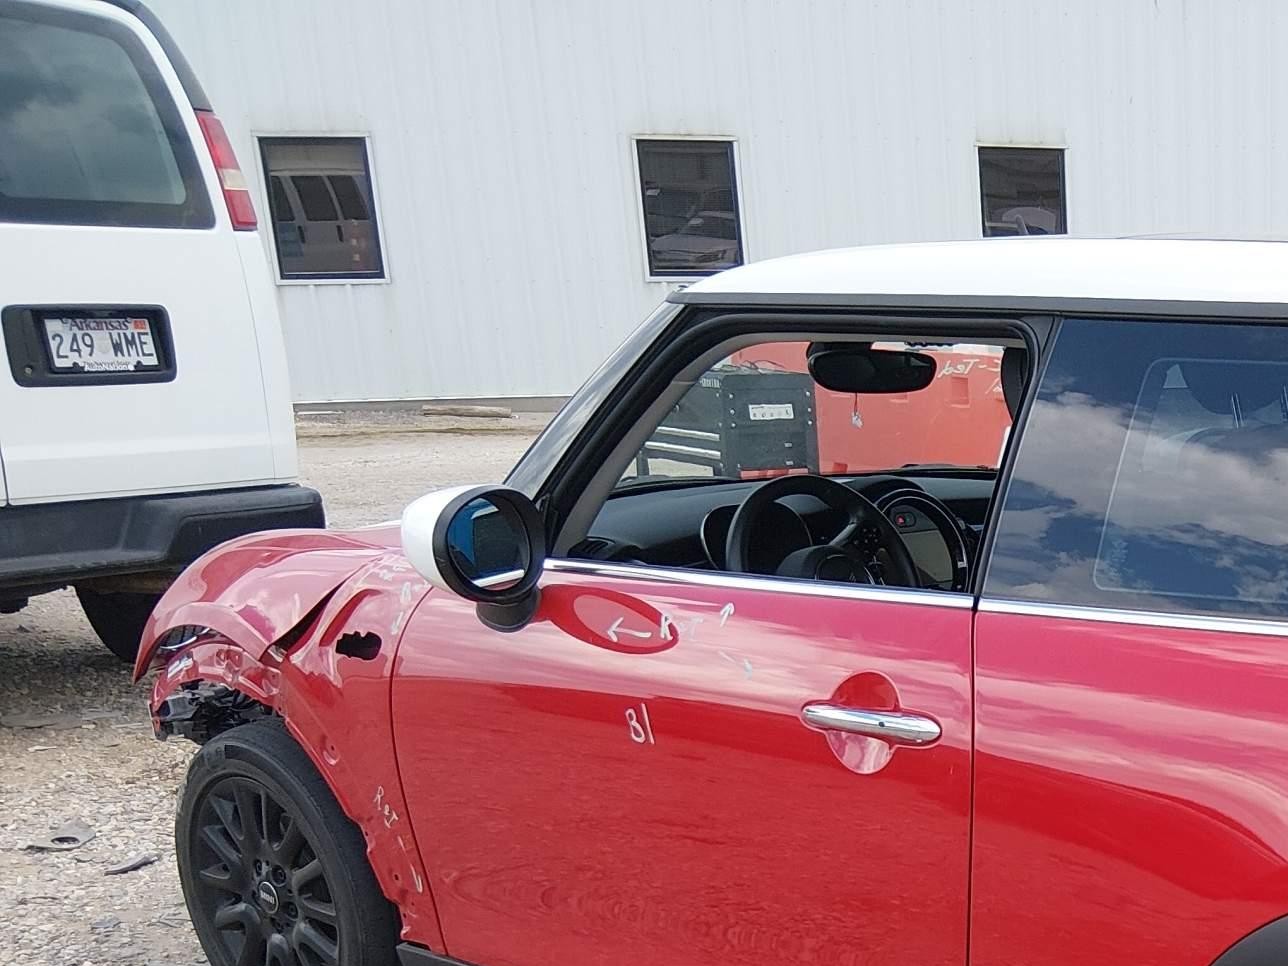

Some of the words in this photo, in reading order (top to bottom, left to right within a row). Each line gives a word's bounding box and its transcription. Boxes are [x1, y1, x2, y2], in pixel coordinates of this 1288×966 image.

[68, 320, 130, 331] Arkansas
[52, 333, 94, 359] 249
[109, 332, 154, 357] WME
